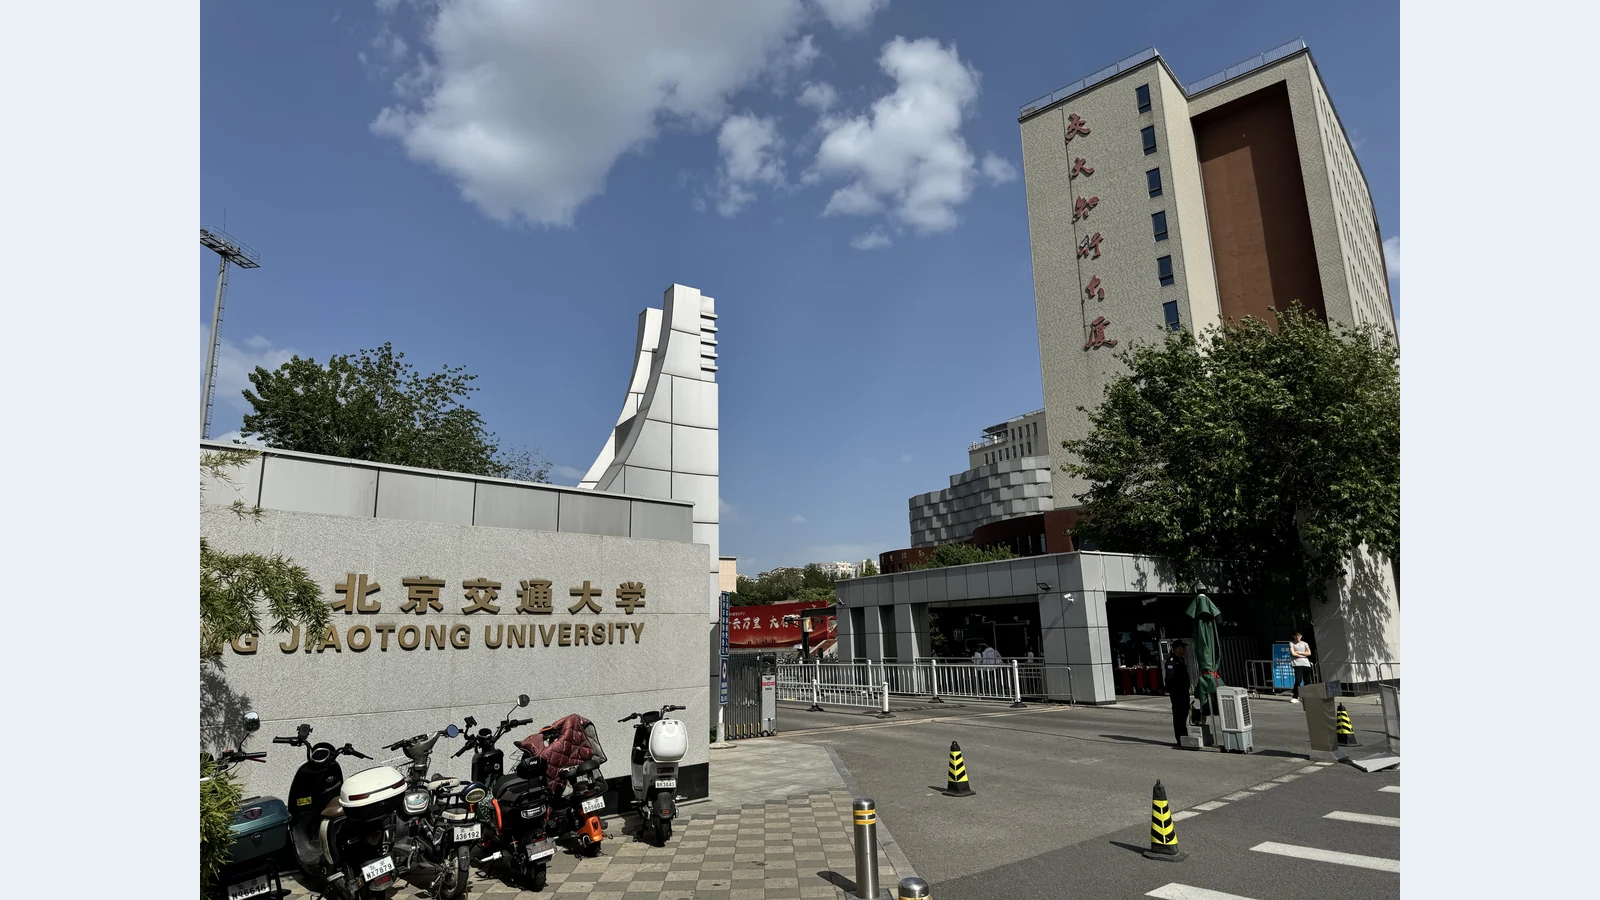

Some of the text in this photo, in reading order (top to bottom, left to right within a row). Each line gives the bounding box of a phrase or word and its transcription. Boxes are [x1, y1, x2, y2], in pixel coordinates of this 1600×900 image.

[331, 573, 647, 615] 北京交通大学
[729, 616, 762, 631] 六万里
[279, 623, 470, 654] JIAOTONG
[484, 621, 645, 648] UNIVERSITY
[455, 831, 480, 841] A36192
